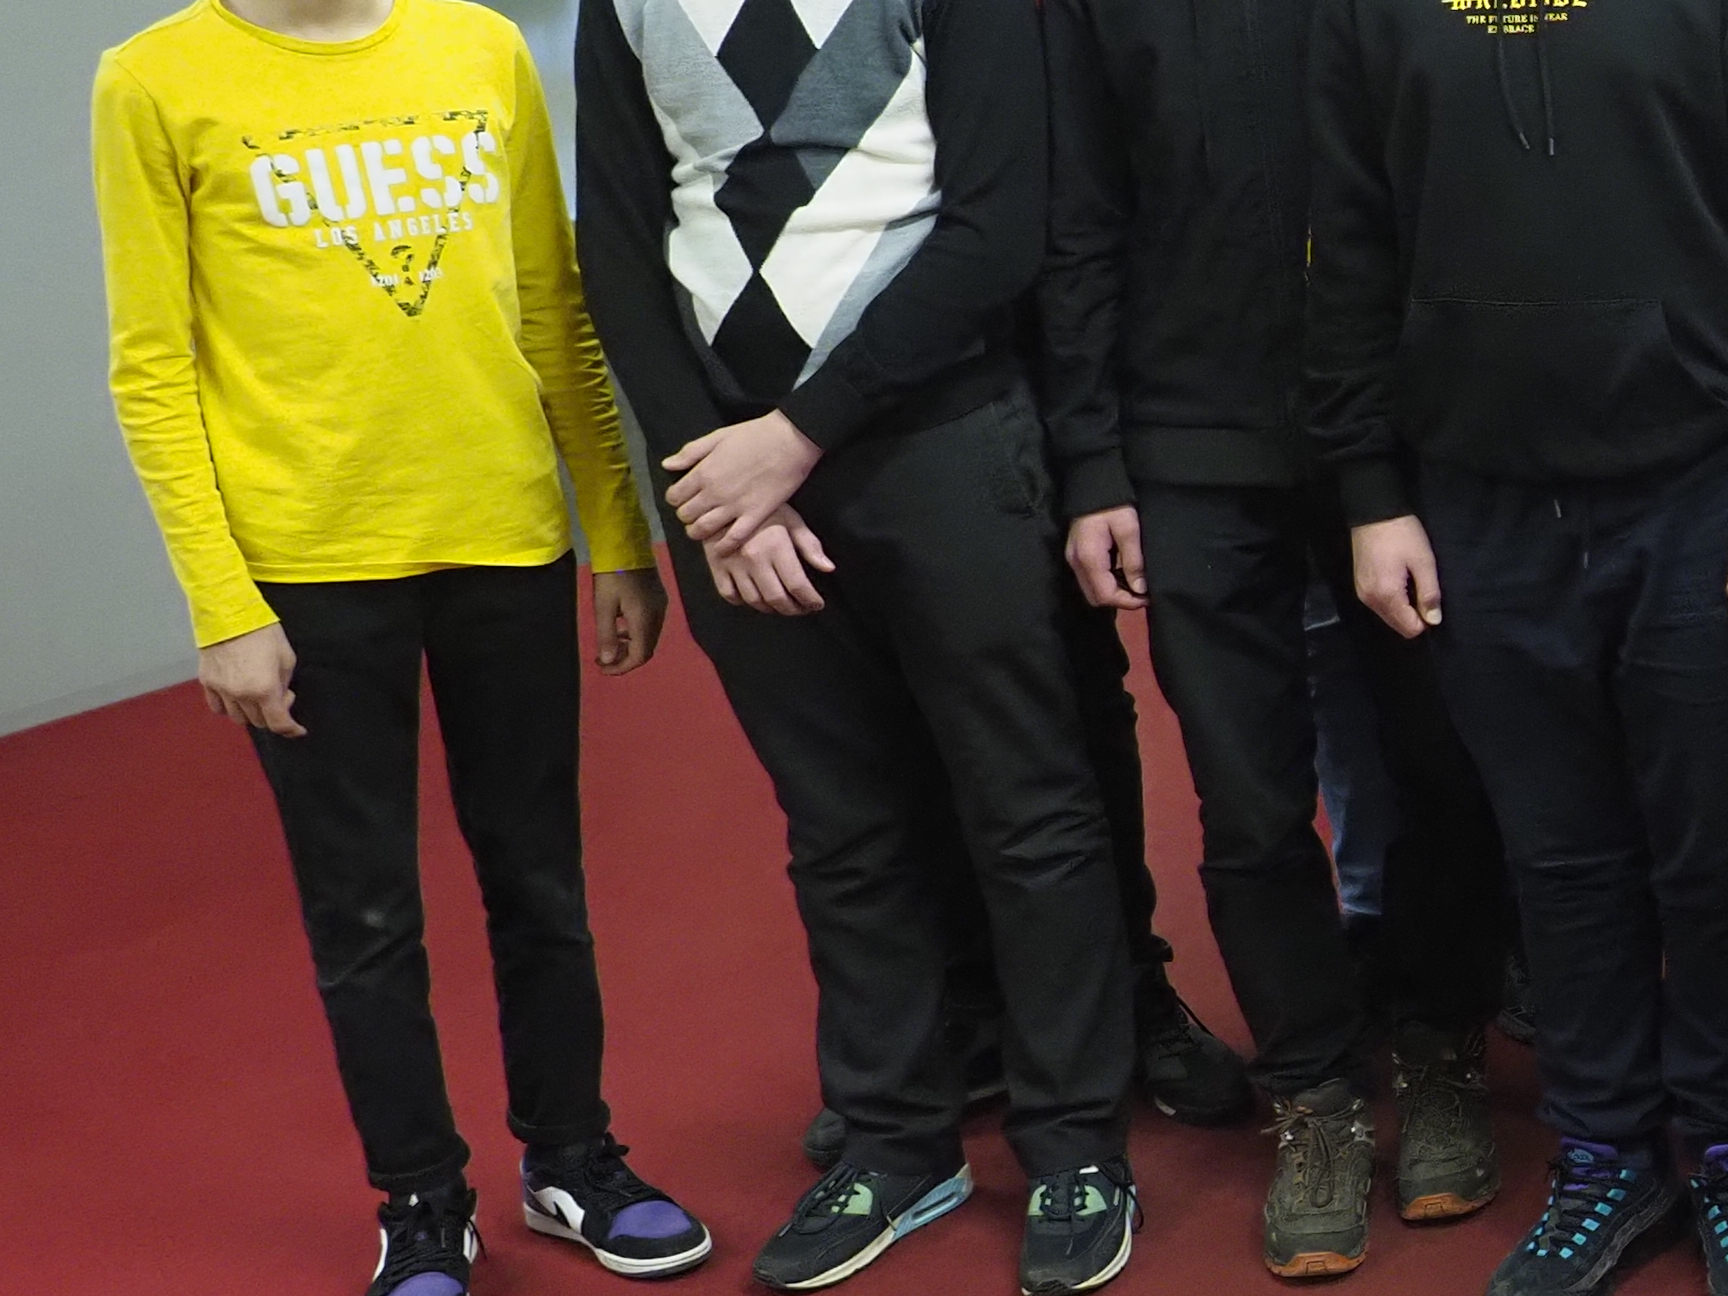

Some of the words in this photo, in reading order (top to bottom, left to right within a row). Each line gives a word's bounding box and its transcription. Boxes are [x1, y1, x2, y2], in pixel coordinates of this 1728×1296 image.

[250, 131, 499, 227] GUESS
[314, 225, 359, 248] LOS
[373, 212, 474, 242] ANGELES
